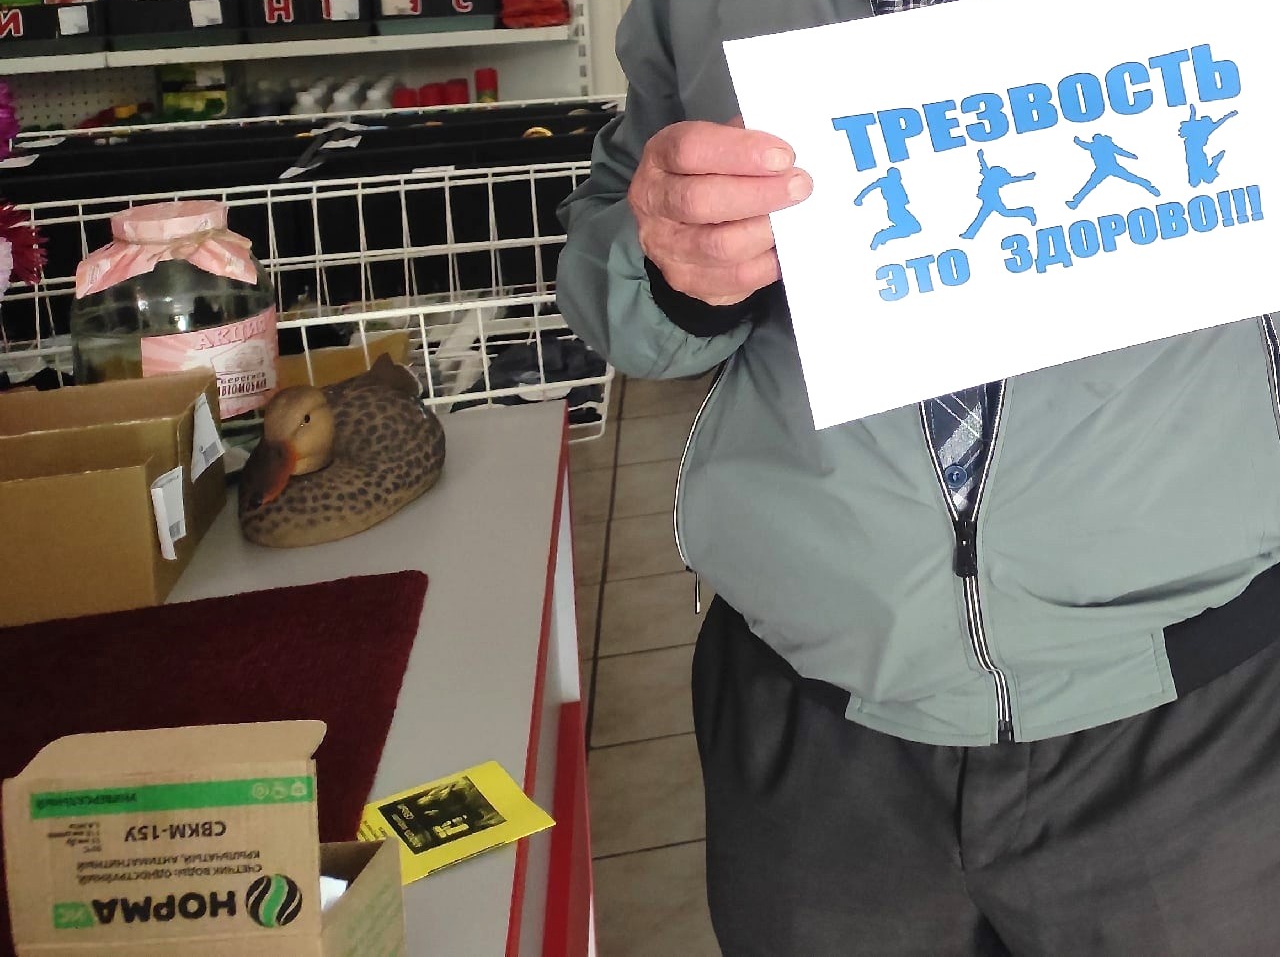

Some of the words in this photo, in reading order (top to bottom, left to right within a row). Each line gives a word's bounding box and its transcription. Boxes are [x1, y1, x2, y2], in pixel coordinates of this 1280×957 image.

[831, 43, 1242, 172] ТРЕЗВОСТЬ
[875, 248, 972, 302] ЭТО
[1000, 184, 1266, 274] ЗДОРОВО!!!
[198, 316, 267, 351] АКЦИЯ
[124, 819, 227, 842] СВКМ-15У
[92, 890, 237, 925] НОРМА
